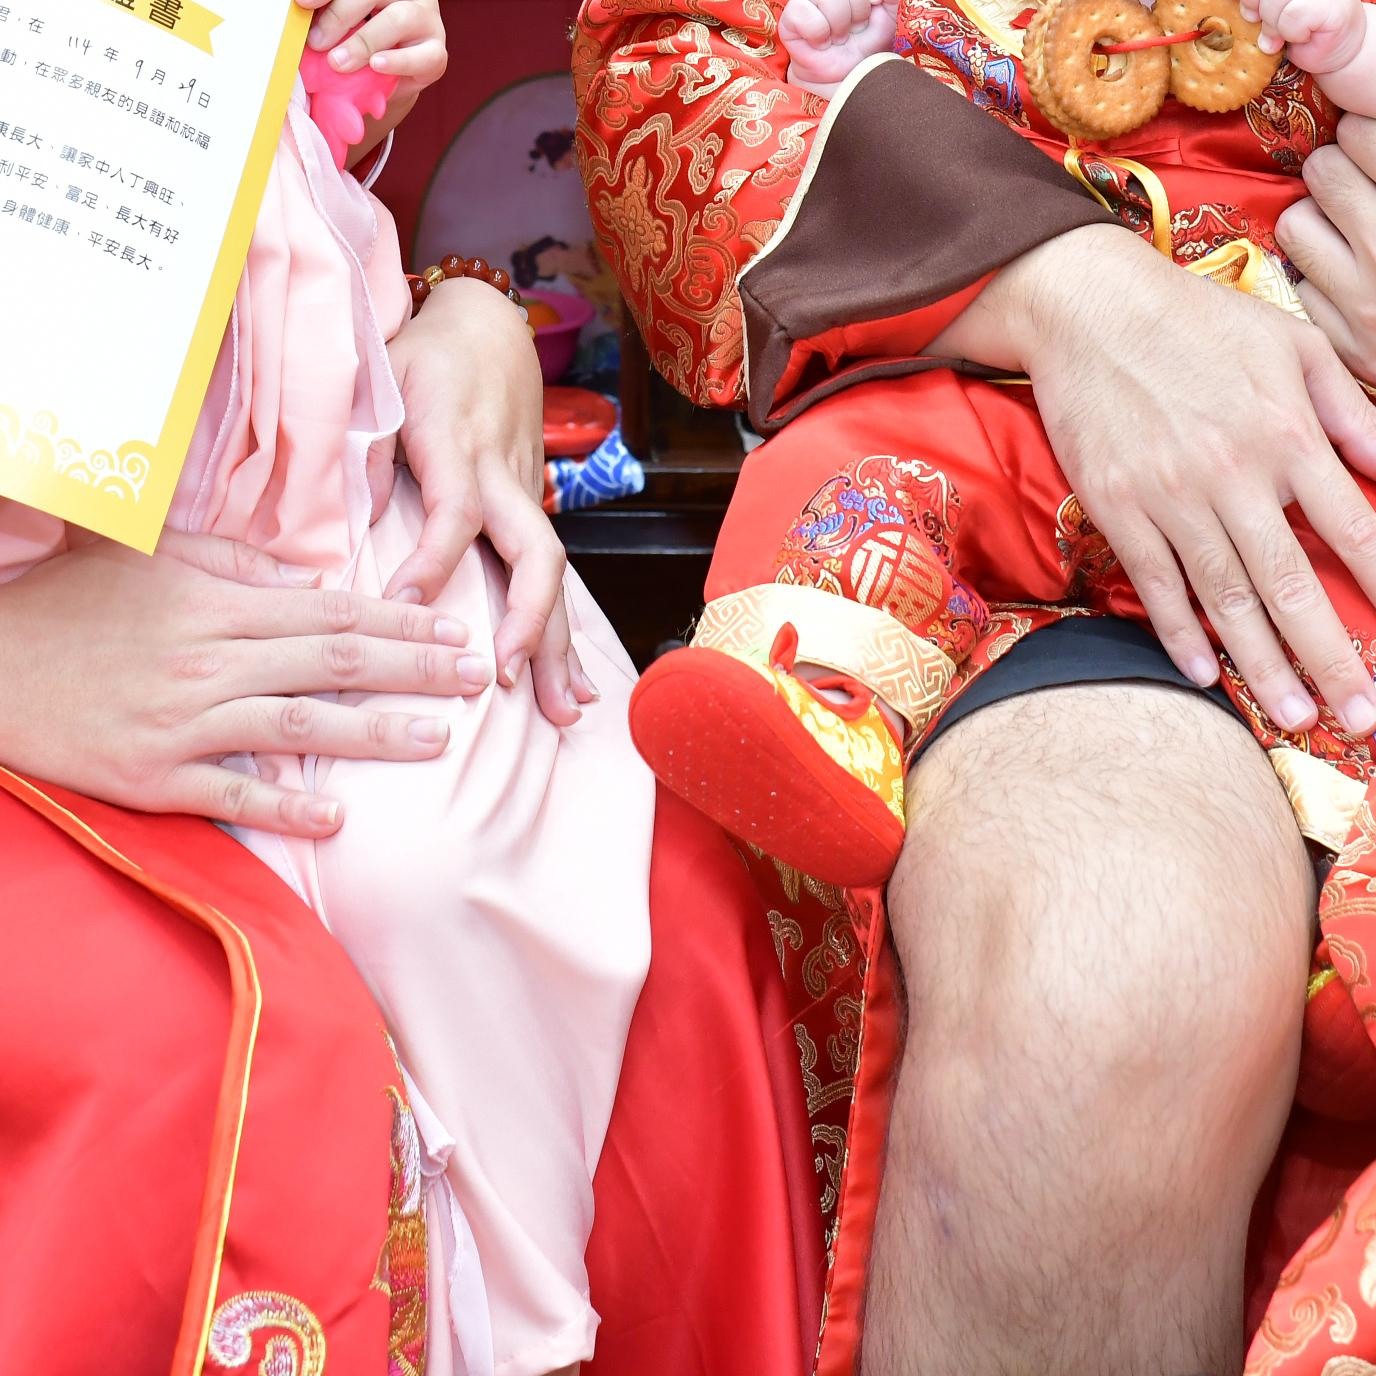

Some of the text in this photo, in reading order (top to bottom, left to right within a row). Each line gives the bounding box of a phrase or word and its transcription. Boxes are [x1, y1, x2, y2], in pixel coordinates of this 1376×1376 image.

[105, 46, 119, 63] 年
[135, 59, 144, 79] 9
[151, 67, 166, 85] 月
[198, 91, 211, 109] 日
